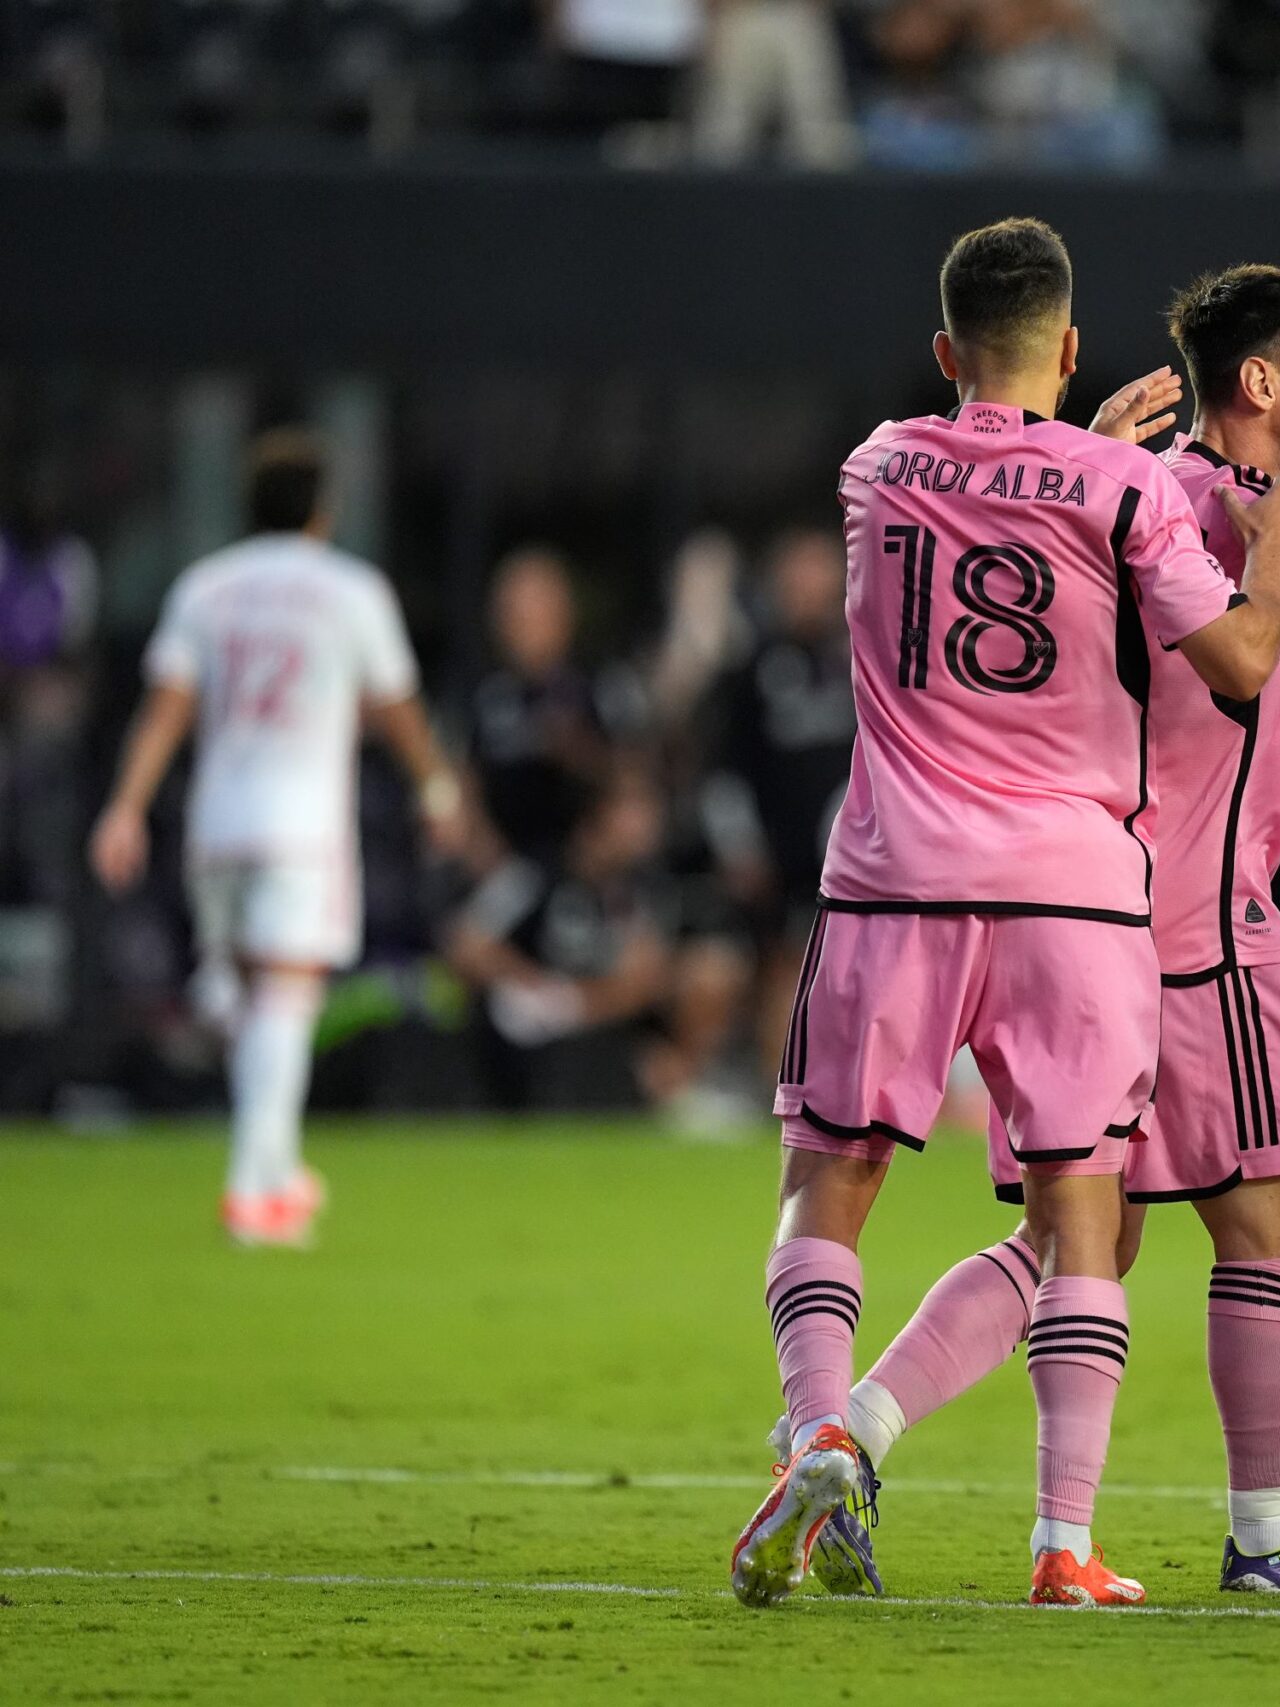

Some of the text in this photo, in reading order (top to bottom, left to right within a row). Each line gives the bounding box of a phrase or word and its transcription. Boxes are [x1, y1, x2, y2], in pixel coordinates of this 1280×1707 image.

[971, 410, 1008, 425] FREEDOM
[973, 425, 1002, 434] DREAM
[981, 463, 1086, 507] ALBA
[884, 523, 1059, 697] 18
